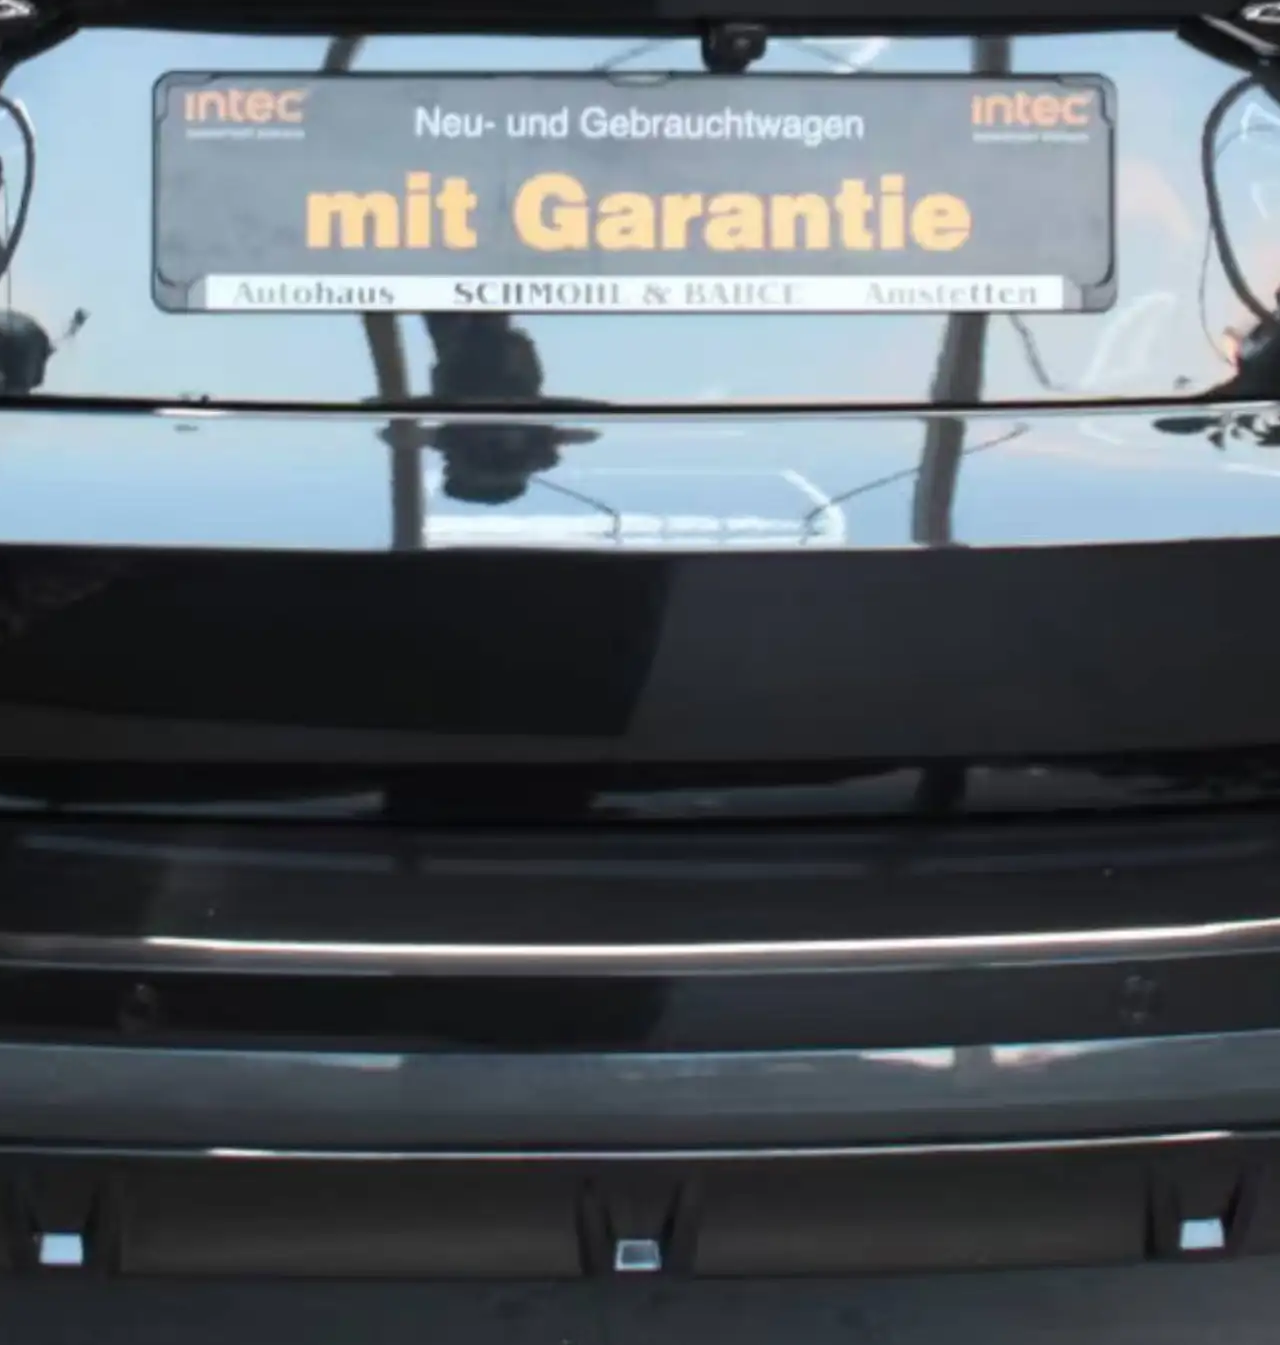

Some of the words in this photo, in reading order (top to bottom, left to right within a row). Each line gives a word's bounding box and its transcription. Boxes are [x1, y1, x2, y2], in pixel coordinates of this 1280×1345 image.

[415, 106, 495, 138] Neu-
[507, 107, 568, 137] und
[579, 106, 864, 146] Gebrauchtwagen
[306, 171, 478, 250] mit
[514, 172, 971, 252] Garantie
[233, 281, 395, 305] Autohaus
[642, 282, 672, 305] &
[865, 282, 1037, 305] Amstetten
